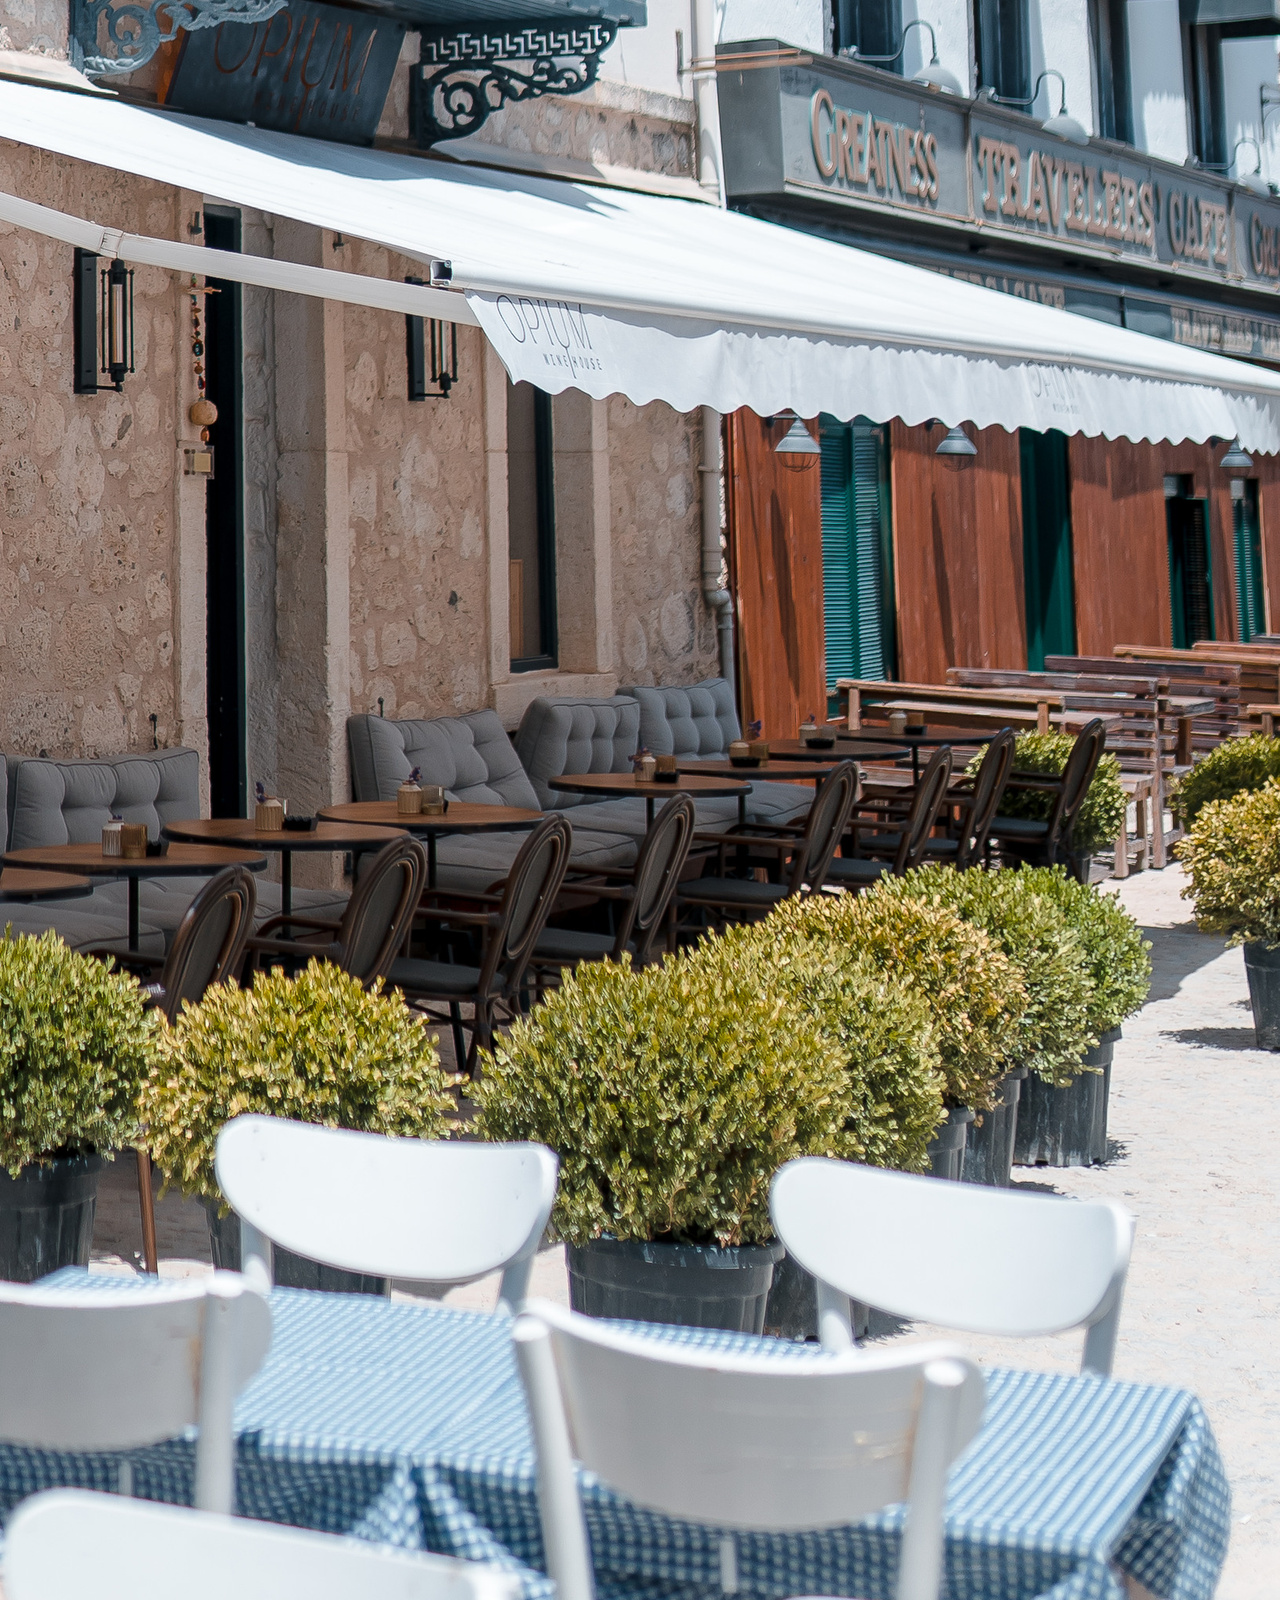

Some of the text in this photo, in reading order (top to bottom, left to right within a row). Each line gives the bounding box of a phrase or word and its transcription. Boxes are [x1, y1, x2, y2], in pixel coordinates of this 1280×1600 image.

[214, 9, 378, 131] OPIUM
[810, 87, 939, 201] GREATNESS
[1170, 189, 1228, 265] CAFE
[496, 294, 593, 379] OPIUM
[543, 353, 603, 371] WINE HOUSE
